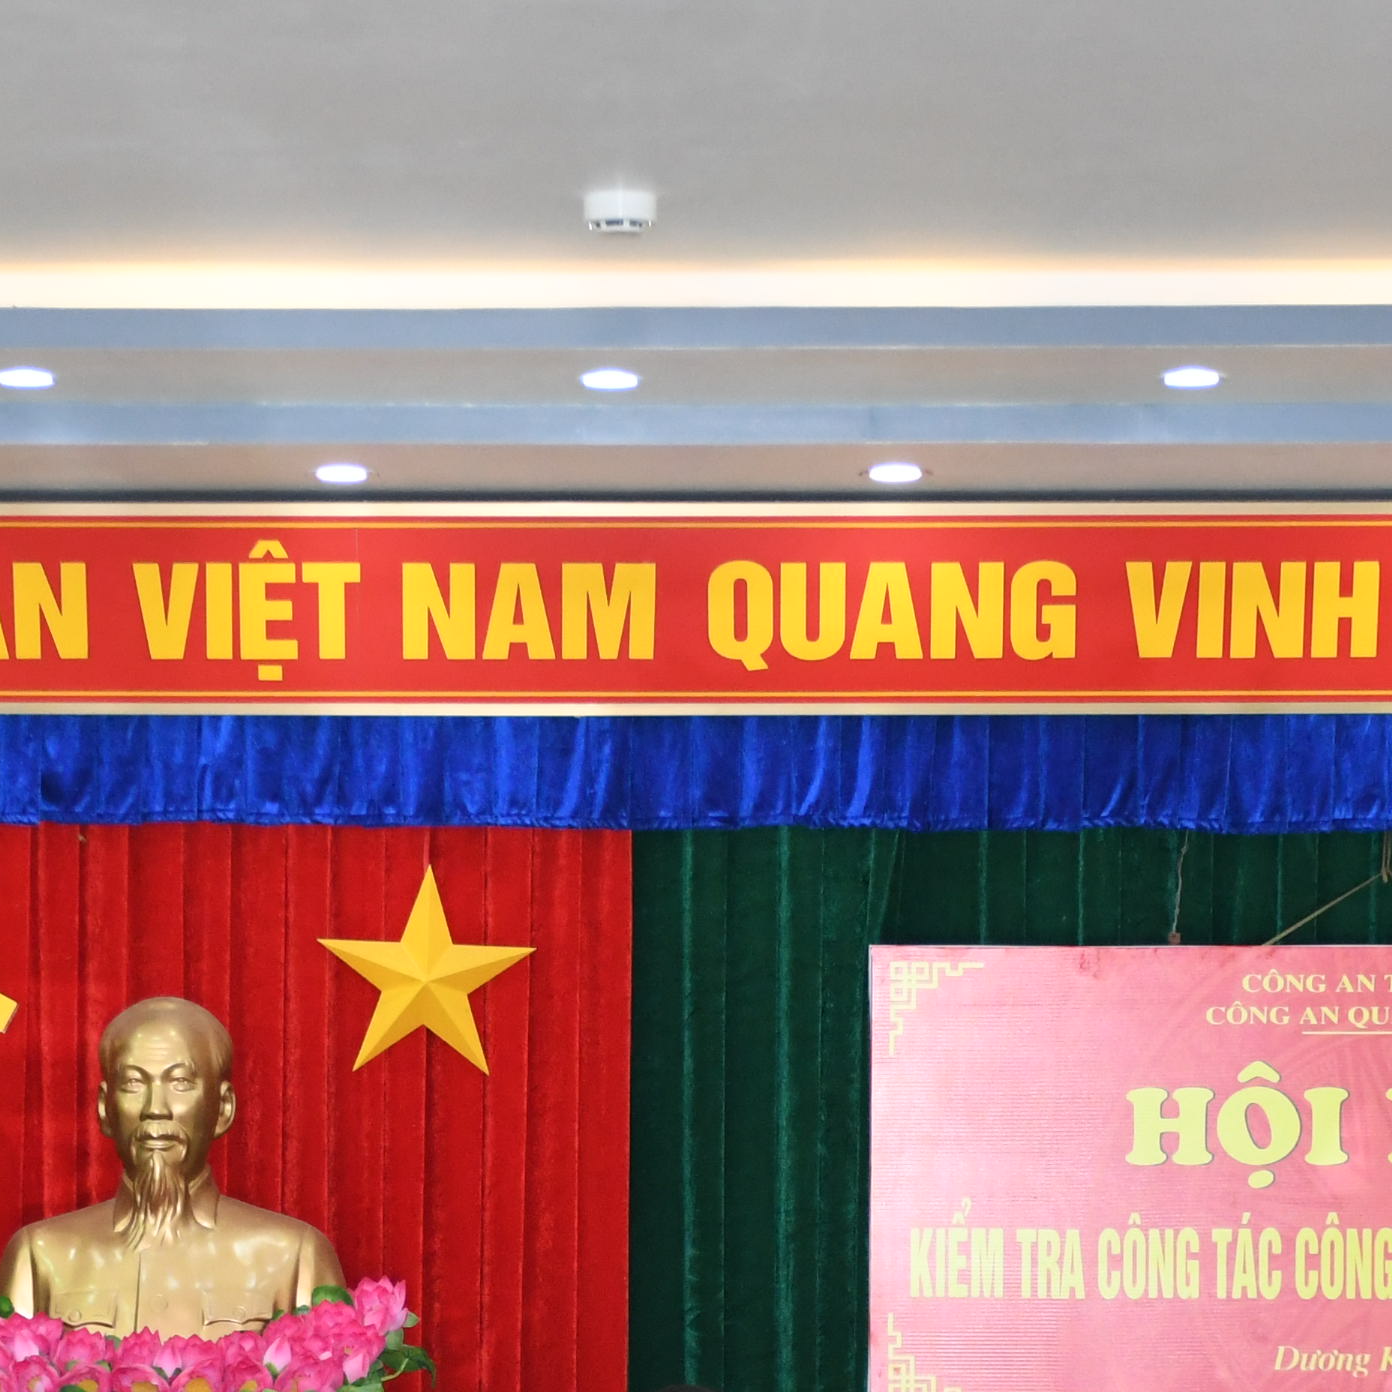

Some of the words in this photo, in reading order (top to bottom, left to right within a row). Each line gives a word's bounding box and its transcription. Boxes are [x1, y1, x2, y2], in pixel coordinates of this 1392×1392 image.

[134, 540, 360, 680] VIỆT
[402, 562, 656, 660] NAM
[706, 560, 1078, 671] QUANG
[1126, 562, 1379, 659] VINH
[1206, 1002, 1290, 1025] CÔNG
[1300, 1006, 1340, 1025] AN
[1242, 969, 1326, 993] CÔNG
[1335, 974, 1376, 992] AN
[1126, 1061, 1349, 1188] HỘI
[911, 1198, 1003, 1298] KIỂM
[1016, 1229, 1085, 1299] TRA
[1098, 1212, 1200, 1299] CÔNG
[1212, 1212, 1282, 1299] TÁC
[1274, 1346, 1370, 1377] Dương
